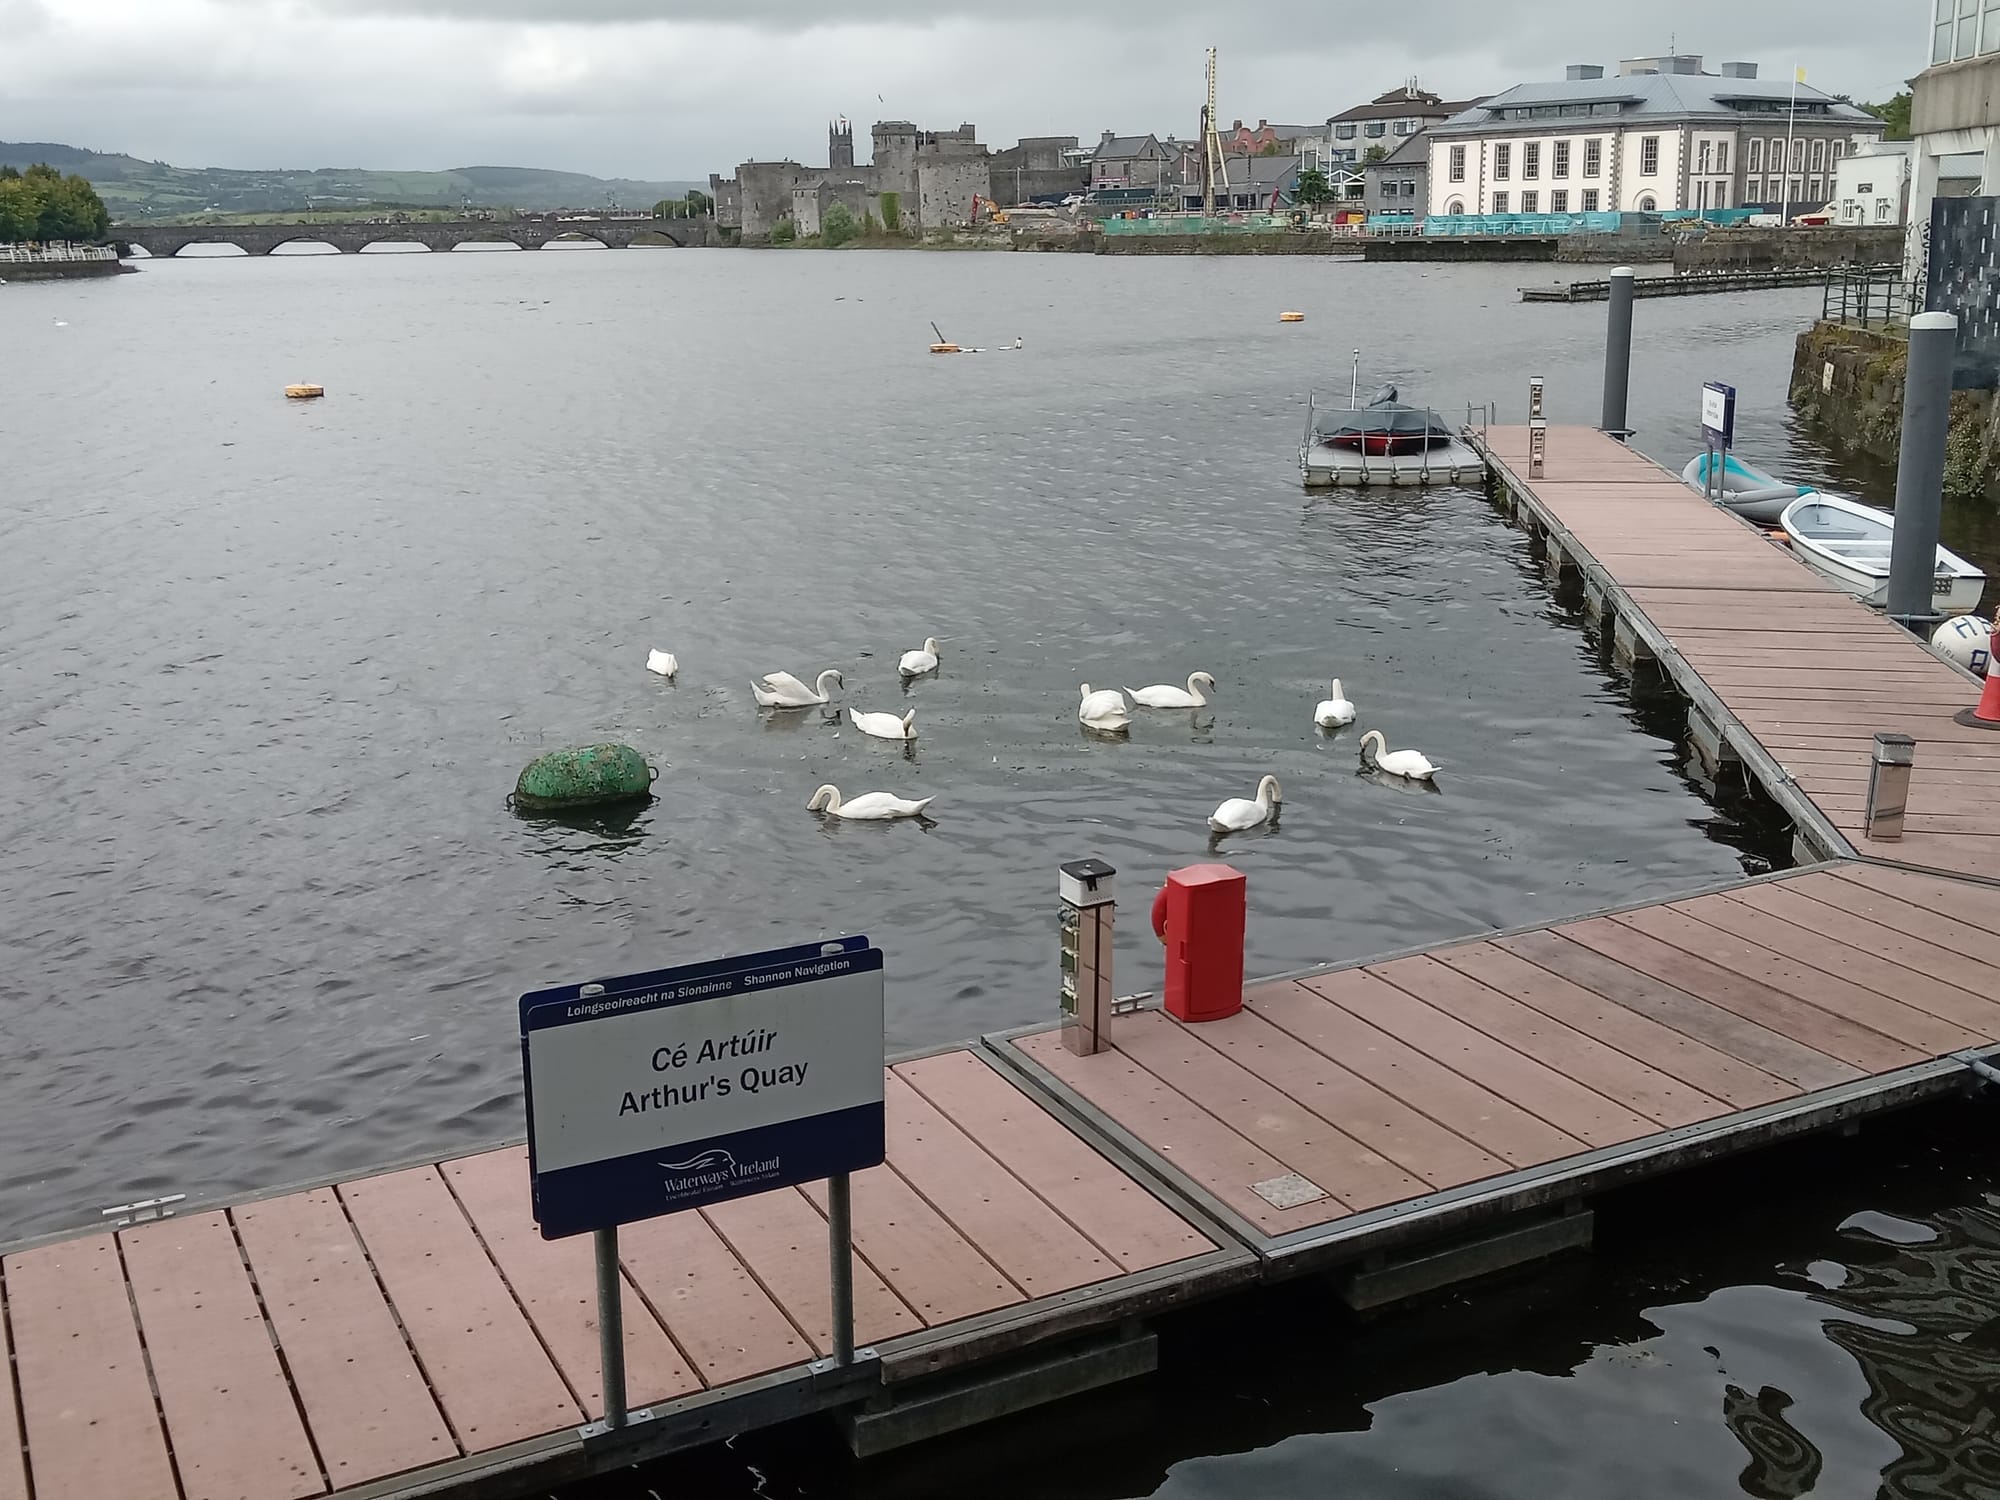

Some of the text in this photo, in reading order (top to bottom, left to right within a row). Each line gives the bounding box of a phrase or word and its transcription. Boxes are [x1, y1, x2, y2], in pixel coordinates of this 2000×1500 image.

[744, 960, 850, 986] Shannon Navigation
[567, 980, 733, 1017] Loingseoireacht na Sionainne
[651, 1029, 777, 1072] Cé Artúir
[618, 1062, 808, 1116] Arthur's Quay
[664, 1170, 729, 1192] Waterways
[740, 1156, 780, 1177] Ireland
